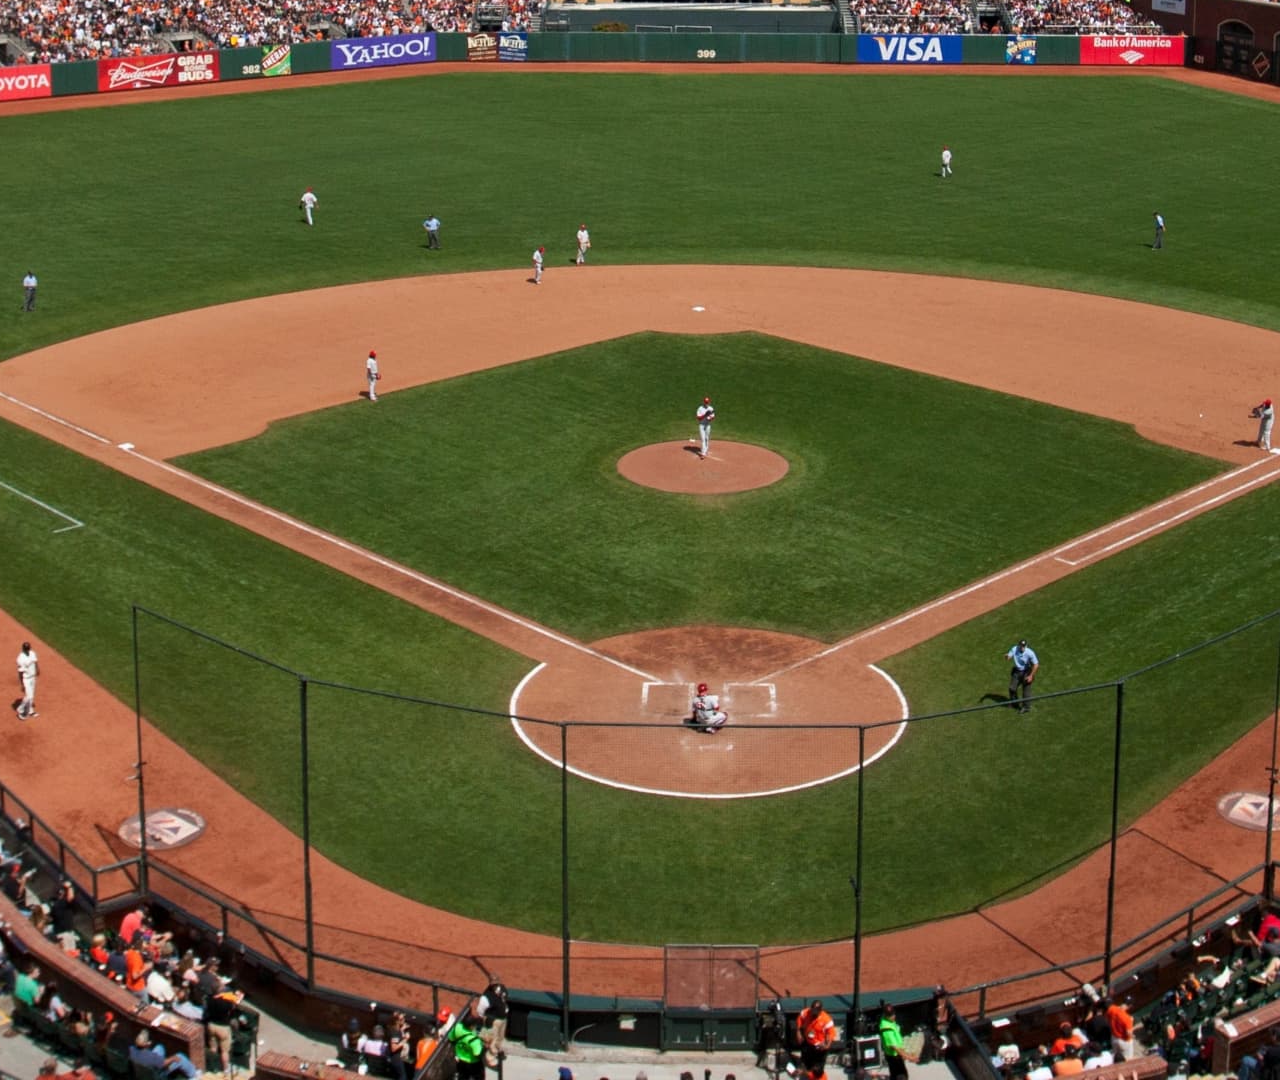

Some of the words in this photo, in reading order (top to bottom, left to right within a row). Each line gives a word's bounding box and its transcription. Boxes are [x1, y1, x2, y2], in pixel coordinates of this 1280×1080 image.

[1093, 37, 1119, 48] Bank
[1120, 37, 1131, 48] of
[1130, 37, 1171, 48] America
[336, 36, 430, 66] YAHOO!
[697, 49, 716, 59] 399
[872, 37, 943, 61] VISA
[177, 54, 213, 66] GRAB
[262, 44, 291, 69] EMERALD
[108, 65, 173, 83] Budweiser
[242, 64, 260, 75] 382
[178, 70, 213, 82] BUDS
